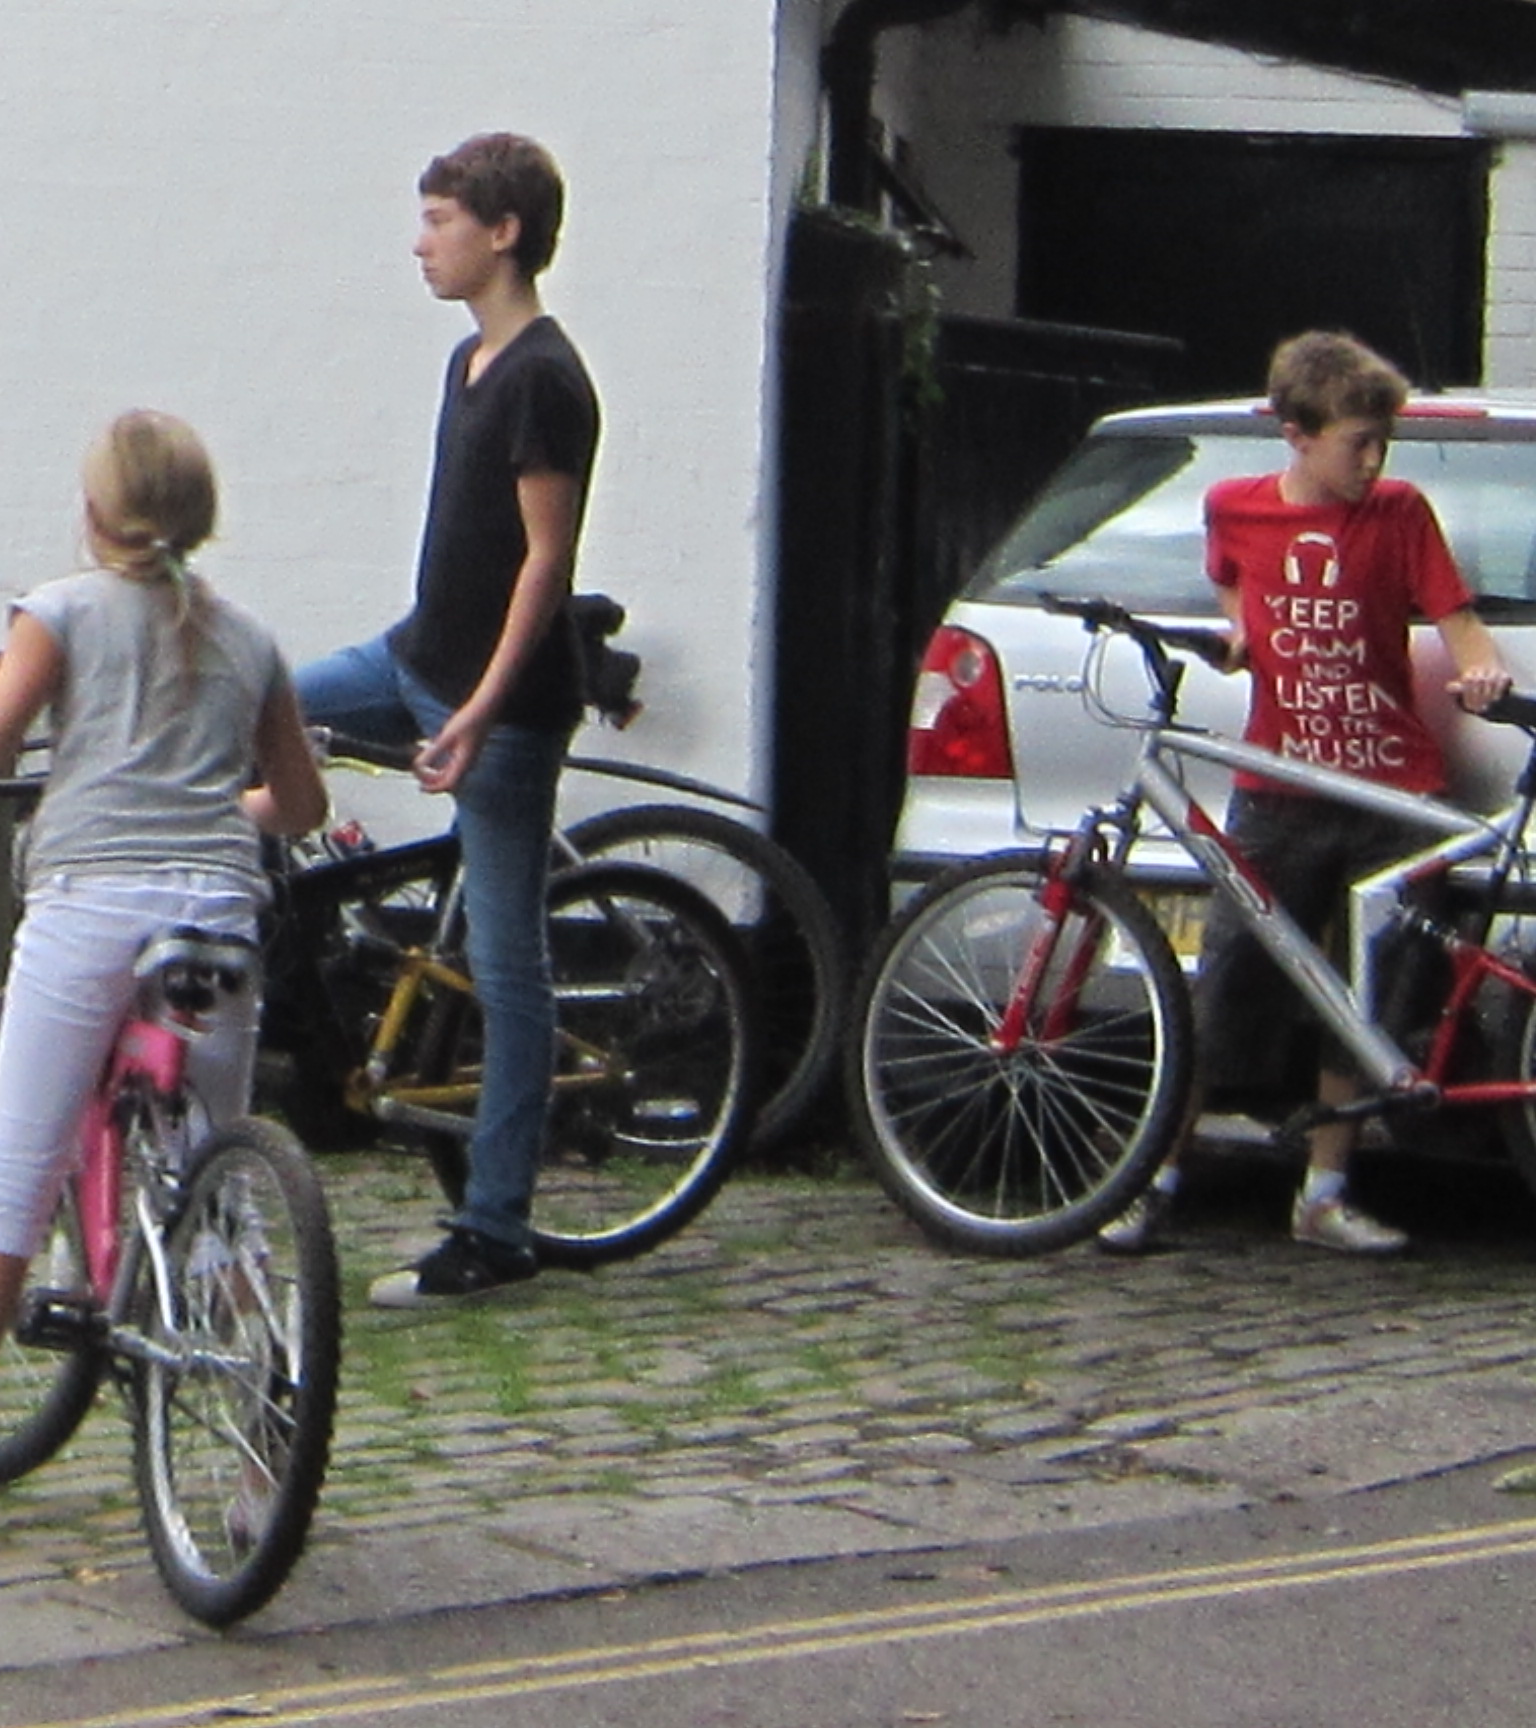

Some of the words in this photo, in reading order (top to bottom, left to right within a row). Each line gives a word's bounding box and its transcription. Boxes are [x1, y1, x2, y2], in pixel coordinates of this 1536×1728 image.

[1270, 627, 1366, 666] CALM
[1276, 675, 1397, 715] LISTEN
[1295, 714, 1332, 737] TO
[1281, 732, 1406, 770] MUSIC
